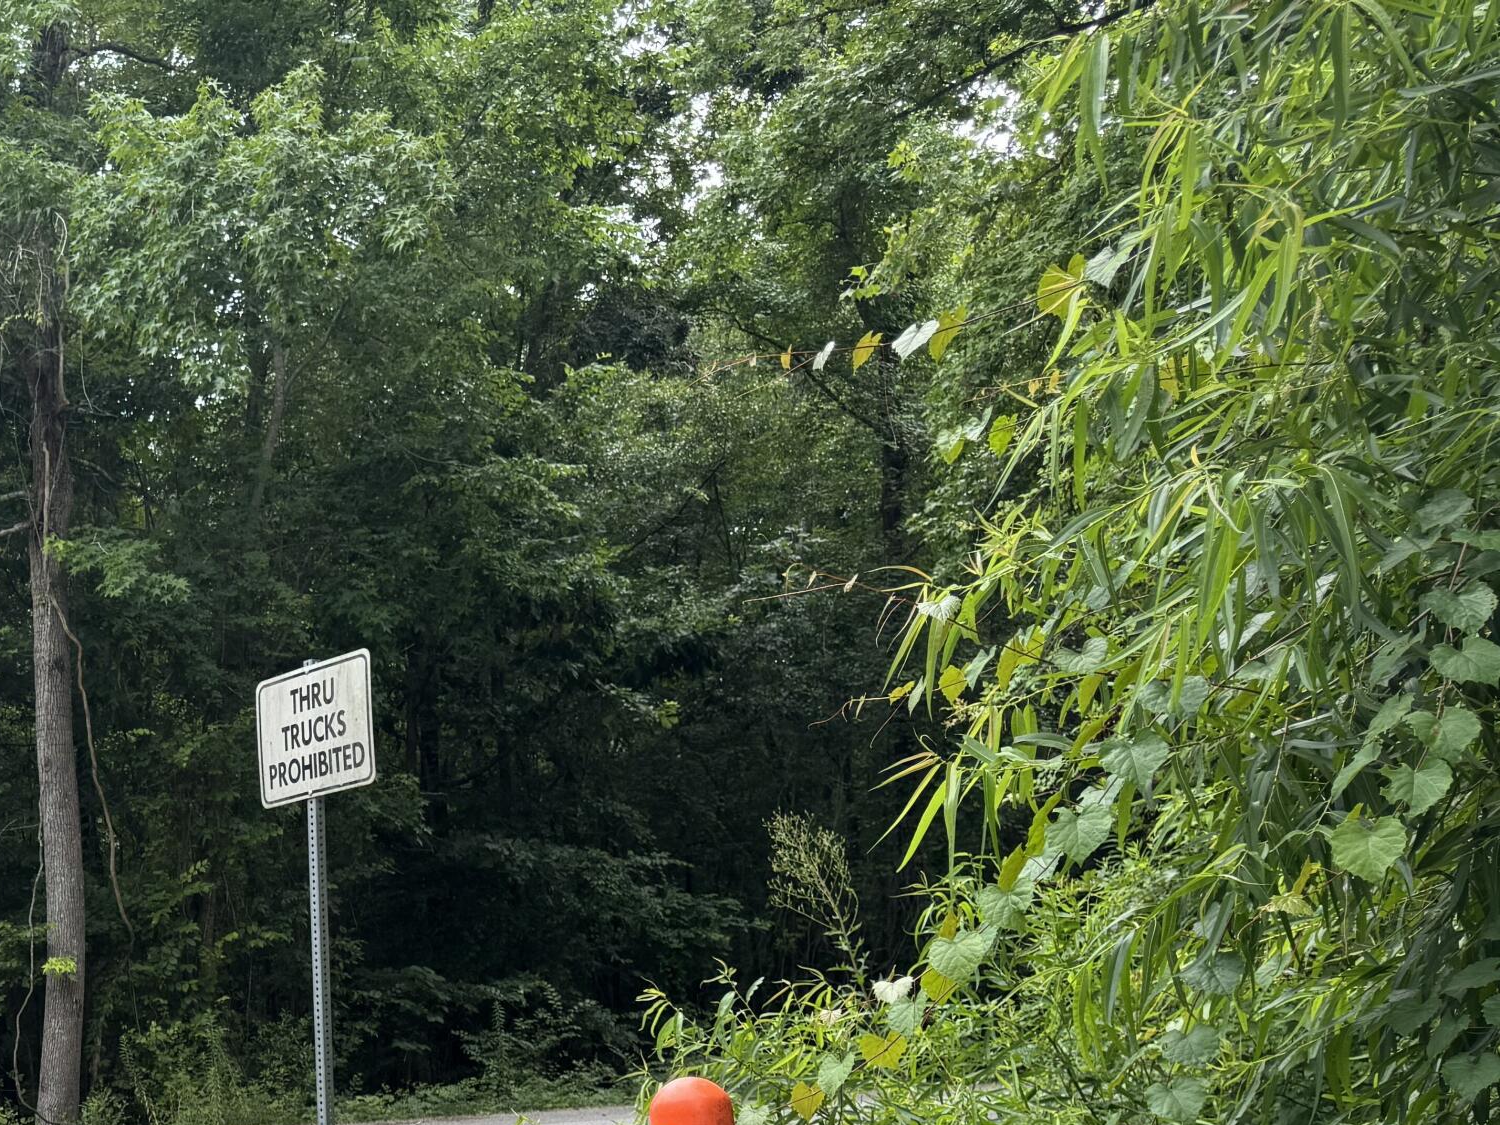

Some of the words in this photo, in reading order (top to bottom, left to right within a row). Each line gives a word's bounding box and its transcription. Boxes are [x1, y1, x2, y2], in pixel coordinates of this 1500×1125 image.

[290, 677, 334, 714] THRU
[282, 710, 346, 751] TRUCKS
[269, 742, 365, 789] PROHIBITED
